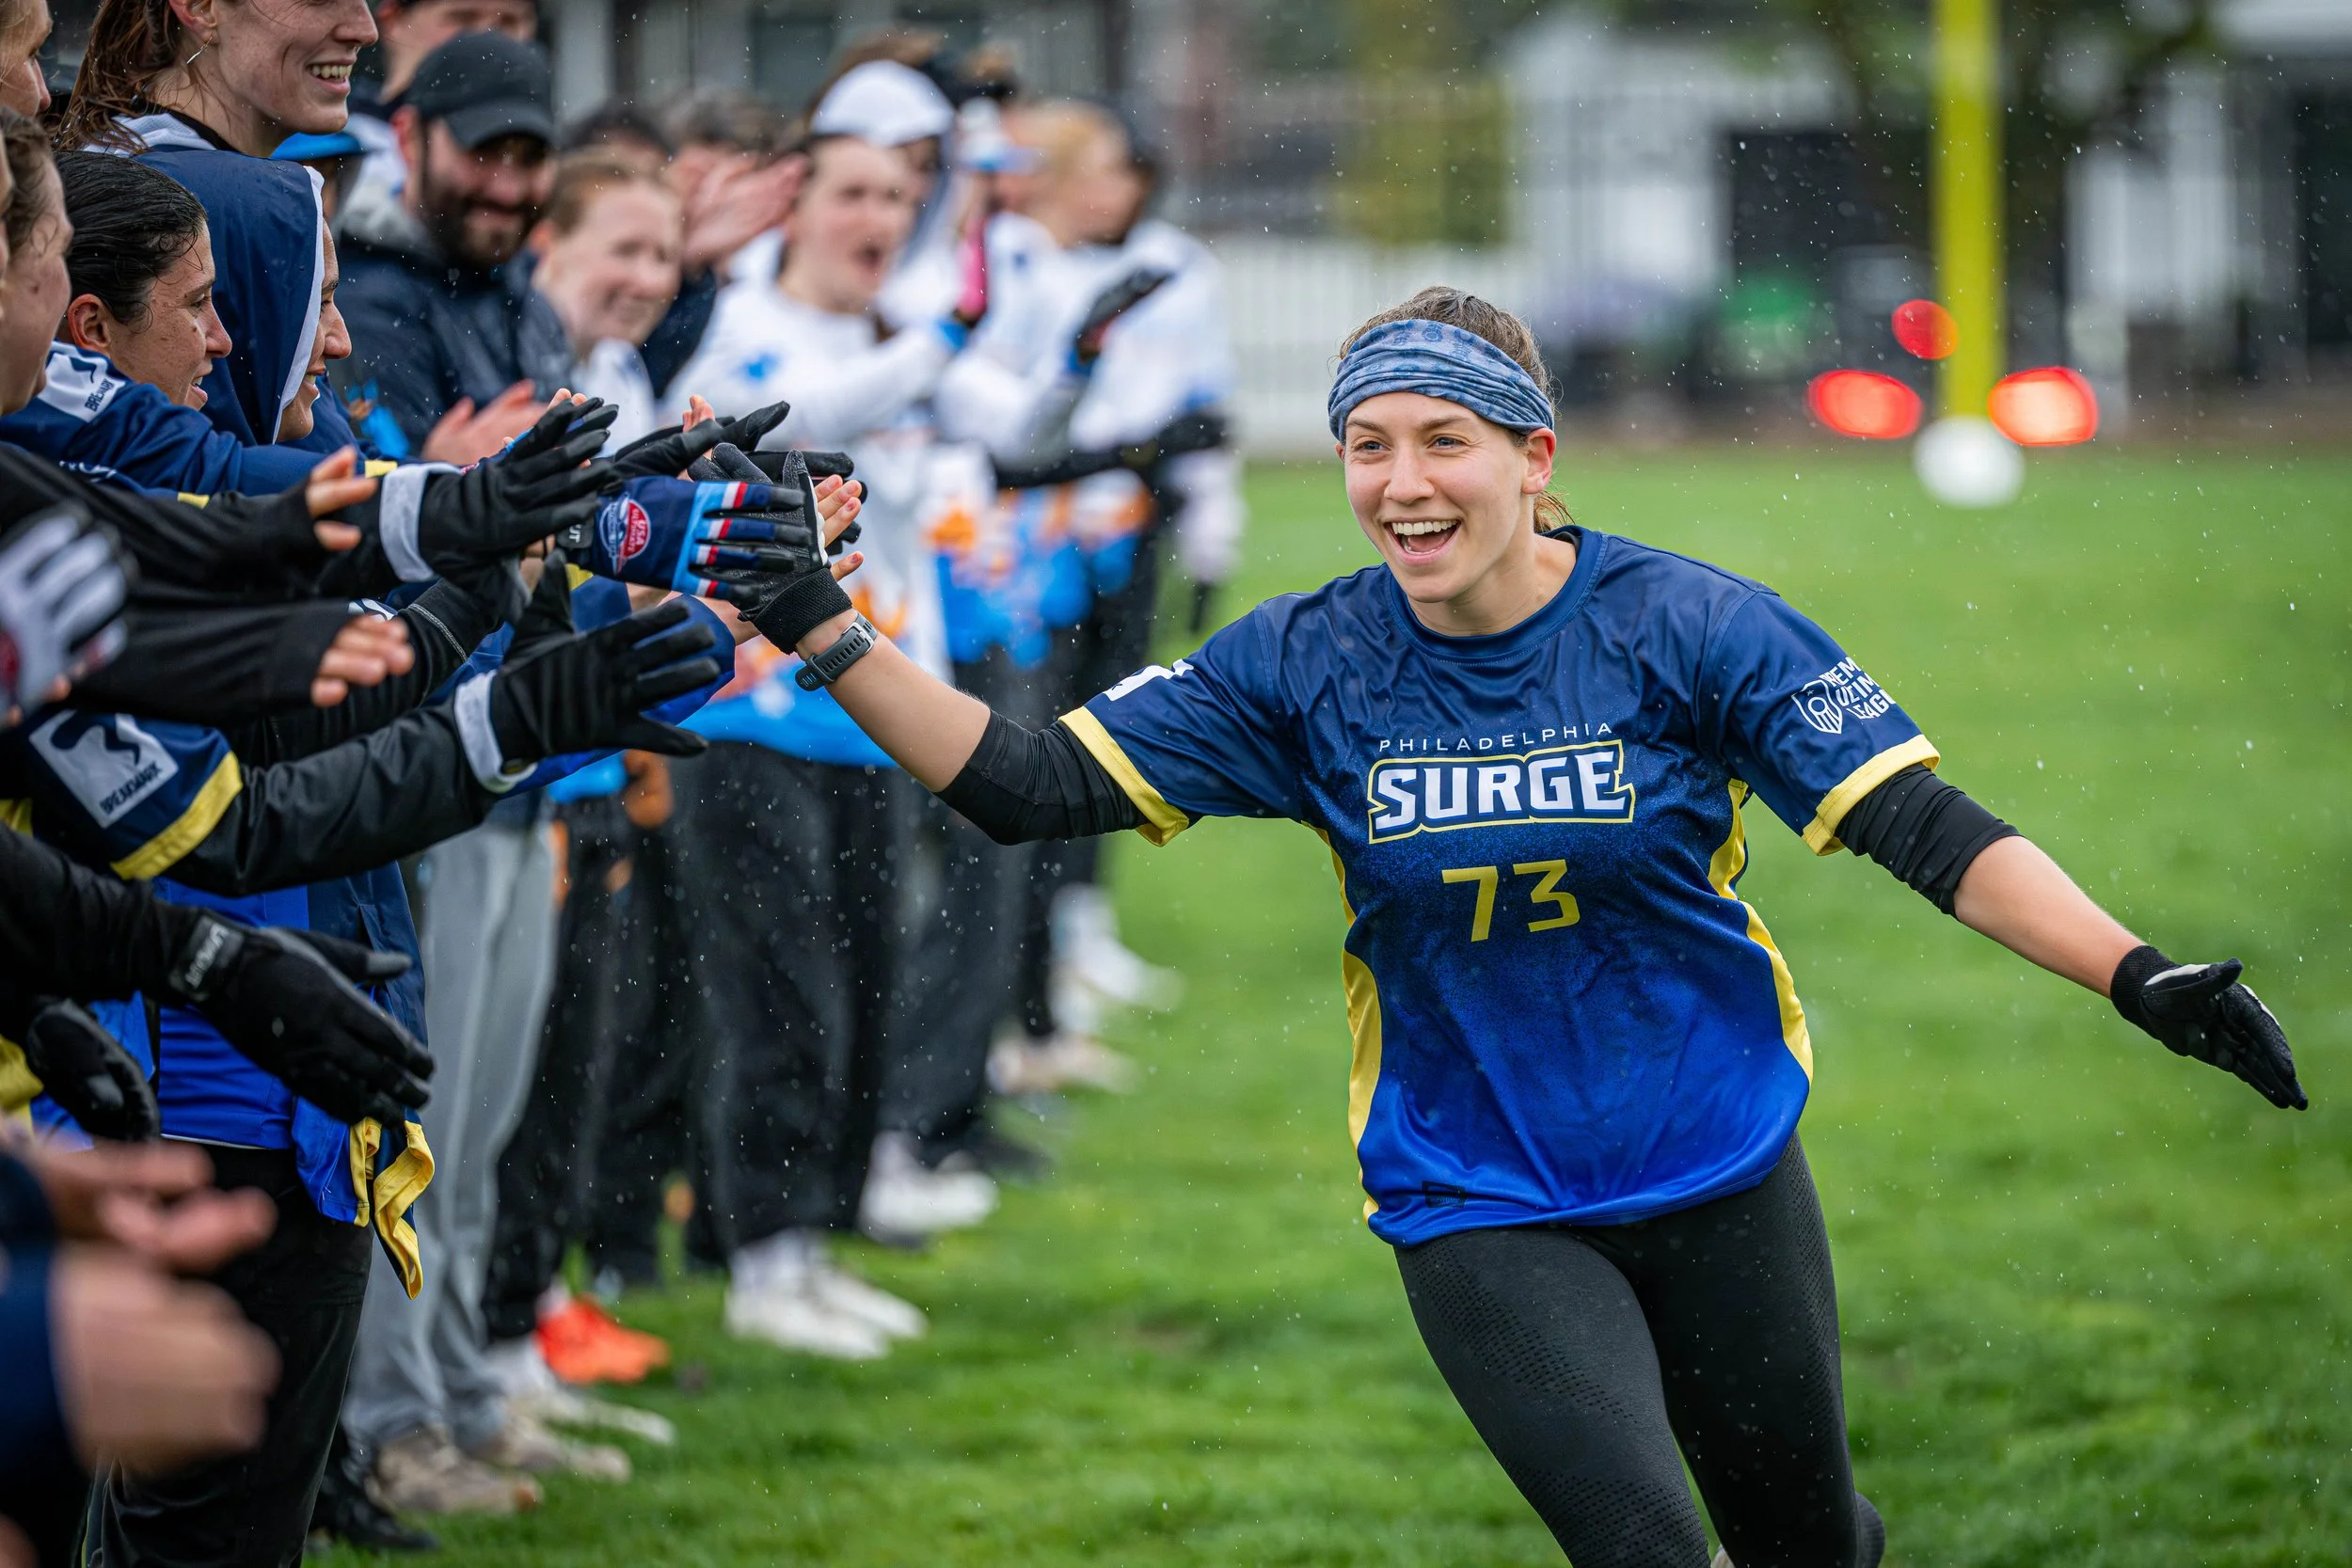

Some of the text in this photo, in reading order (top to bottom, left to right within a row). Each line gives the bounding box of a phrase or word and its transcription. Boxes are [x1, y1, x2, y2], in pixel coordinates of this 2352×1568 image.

[1378, 721, 1613, 752] PHILADELPHIA
[1373, 750, 1629, 832] SURGE
[1440, 858, 1581, 942] 73
